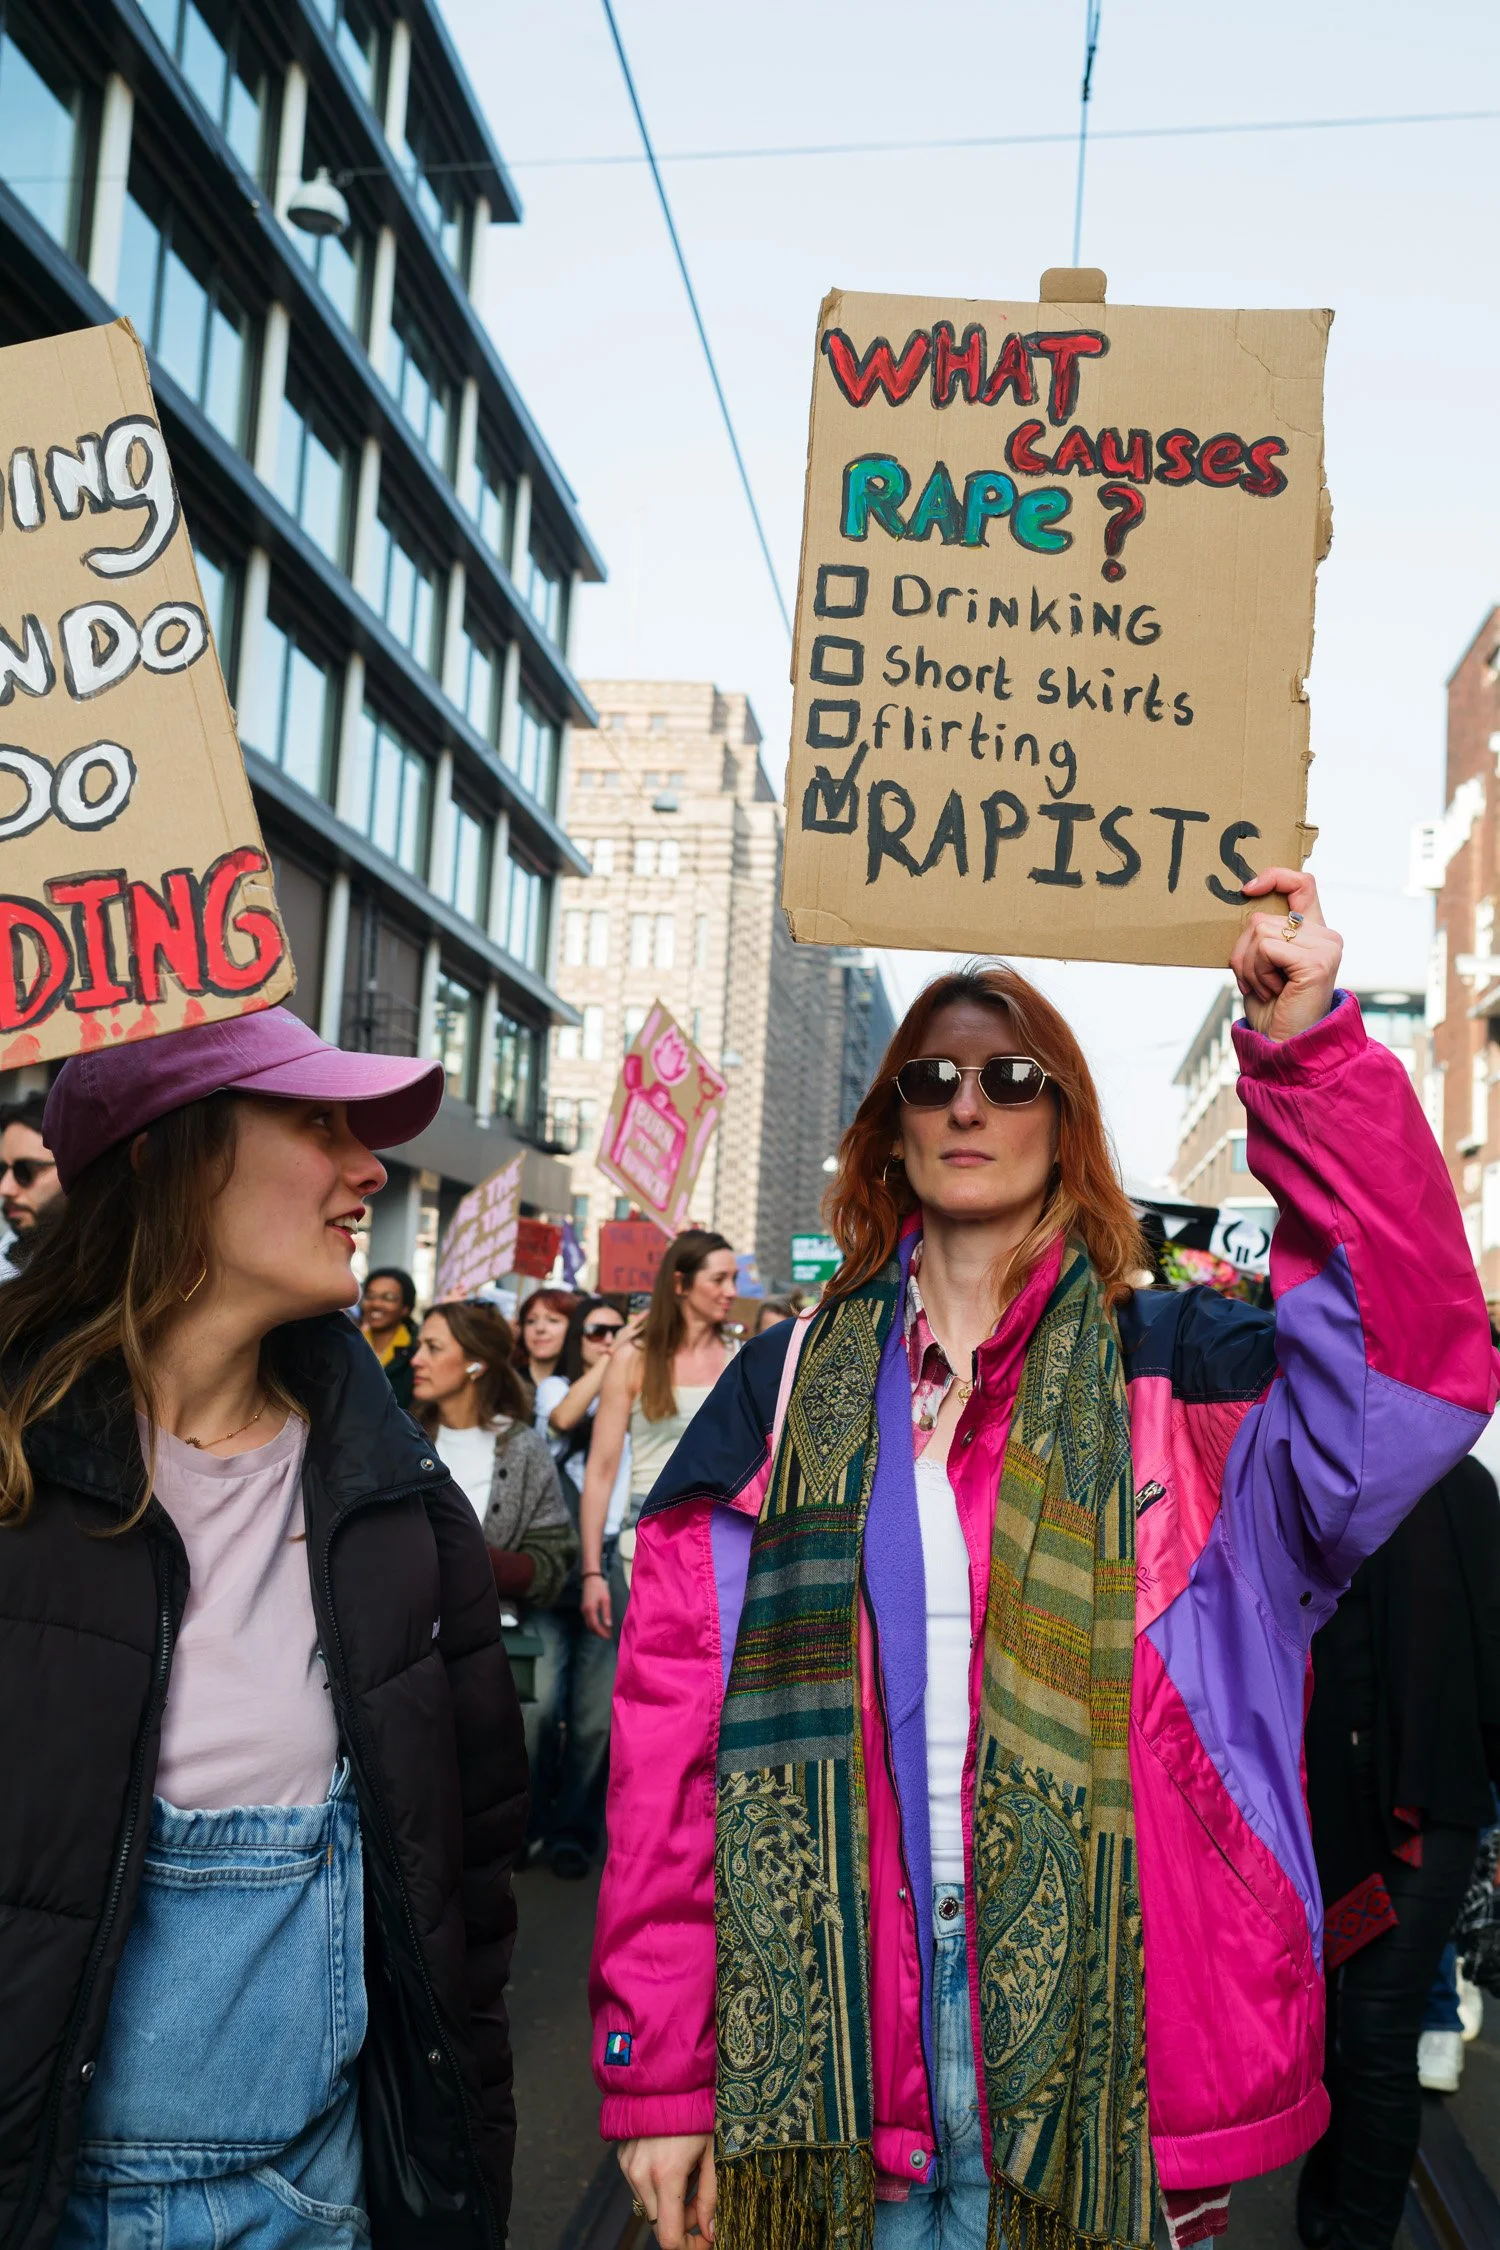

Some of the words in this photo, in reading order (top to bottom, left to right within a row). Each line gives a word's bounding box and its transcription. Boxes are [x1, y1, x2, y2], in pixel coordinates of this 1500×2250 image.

[821, 320, 1111, 427] WHAT
[882, 644, 1014, 701] Short
[872, 703, 1077, 799] flirting
[866, 779, 1262, 905] RAPISTS
